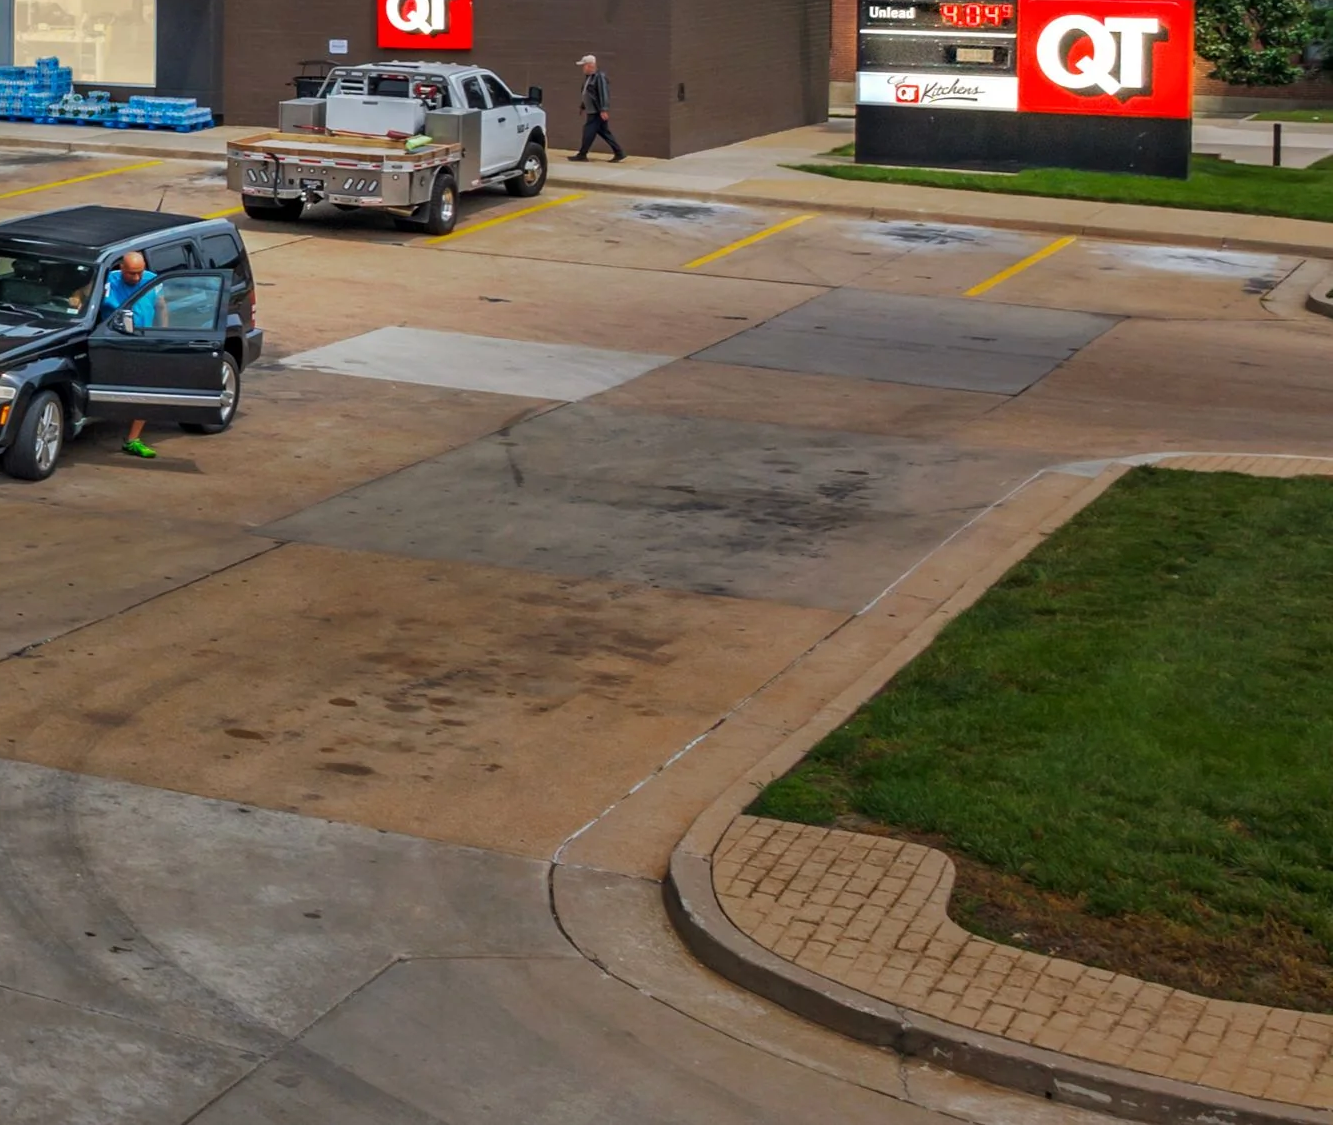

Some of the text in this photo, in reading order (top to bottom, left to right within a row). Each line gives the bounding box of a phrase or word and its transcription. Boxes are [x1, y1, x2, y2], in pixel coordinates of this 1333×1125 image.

[869, 6, 916, 19] Unlead
[1035, 14, 1160, 96] QT
[896, 78, 985, 102] QT Kitchens
